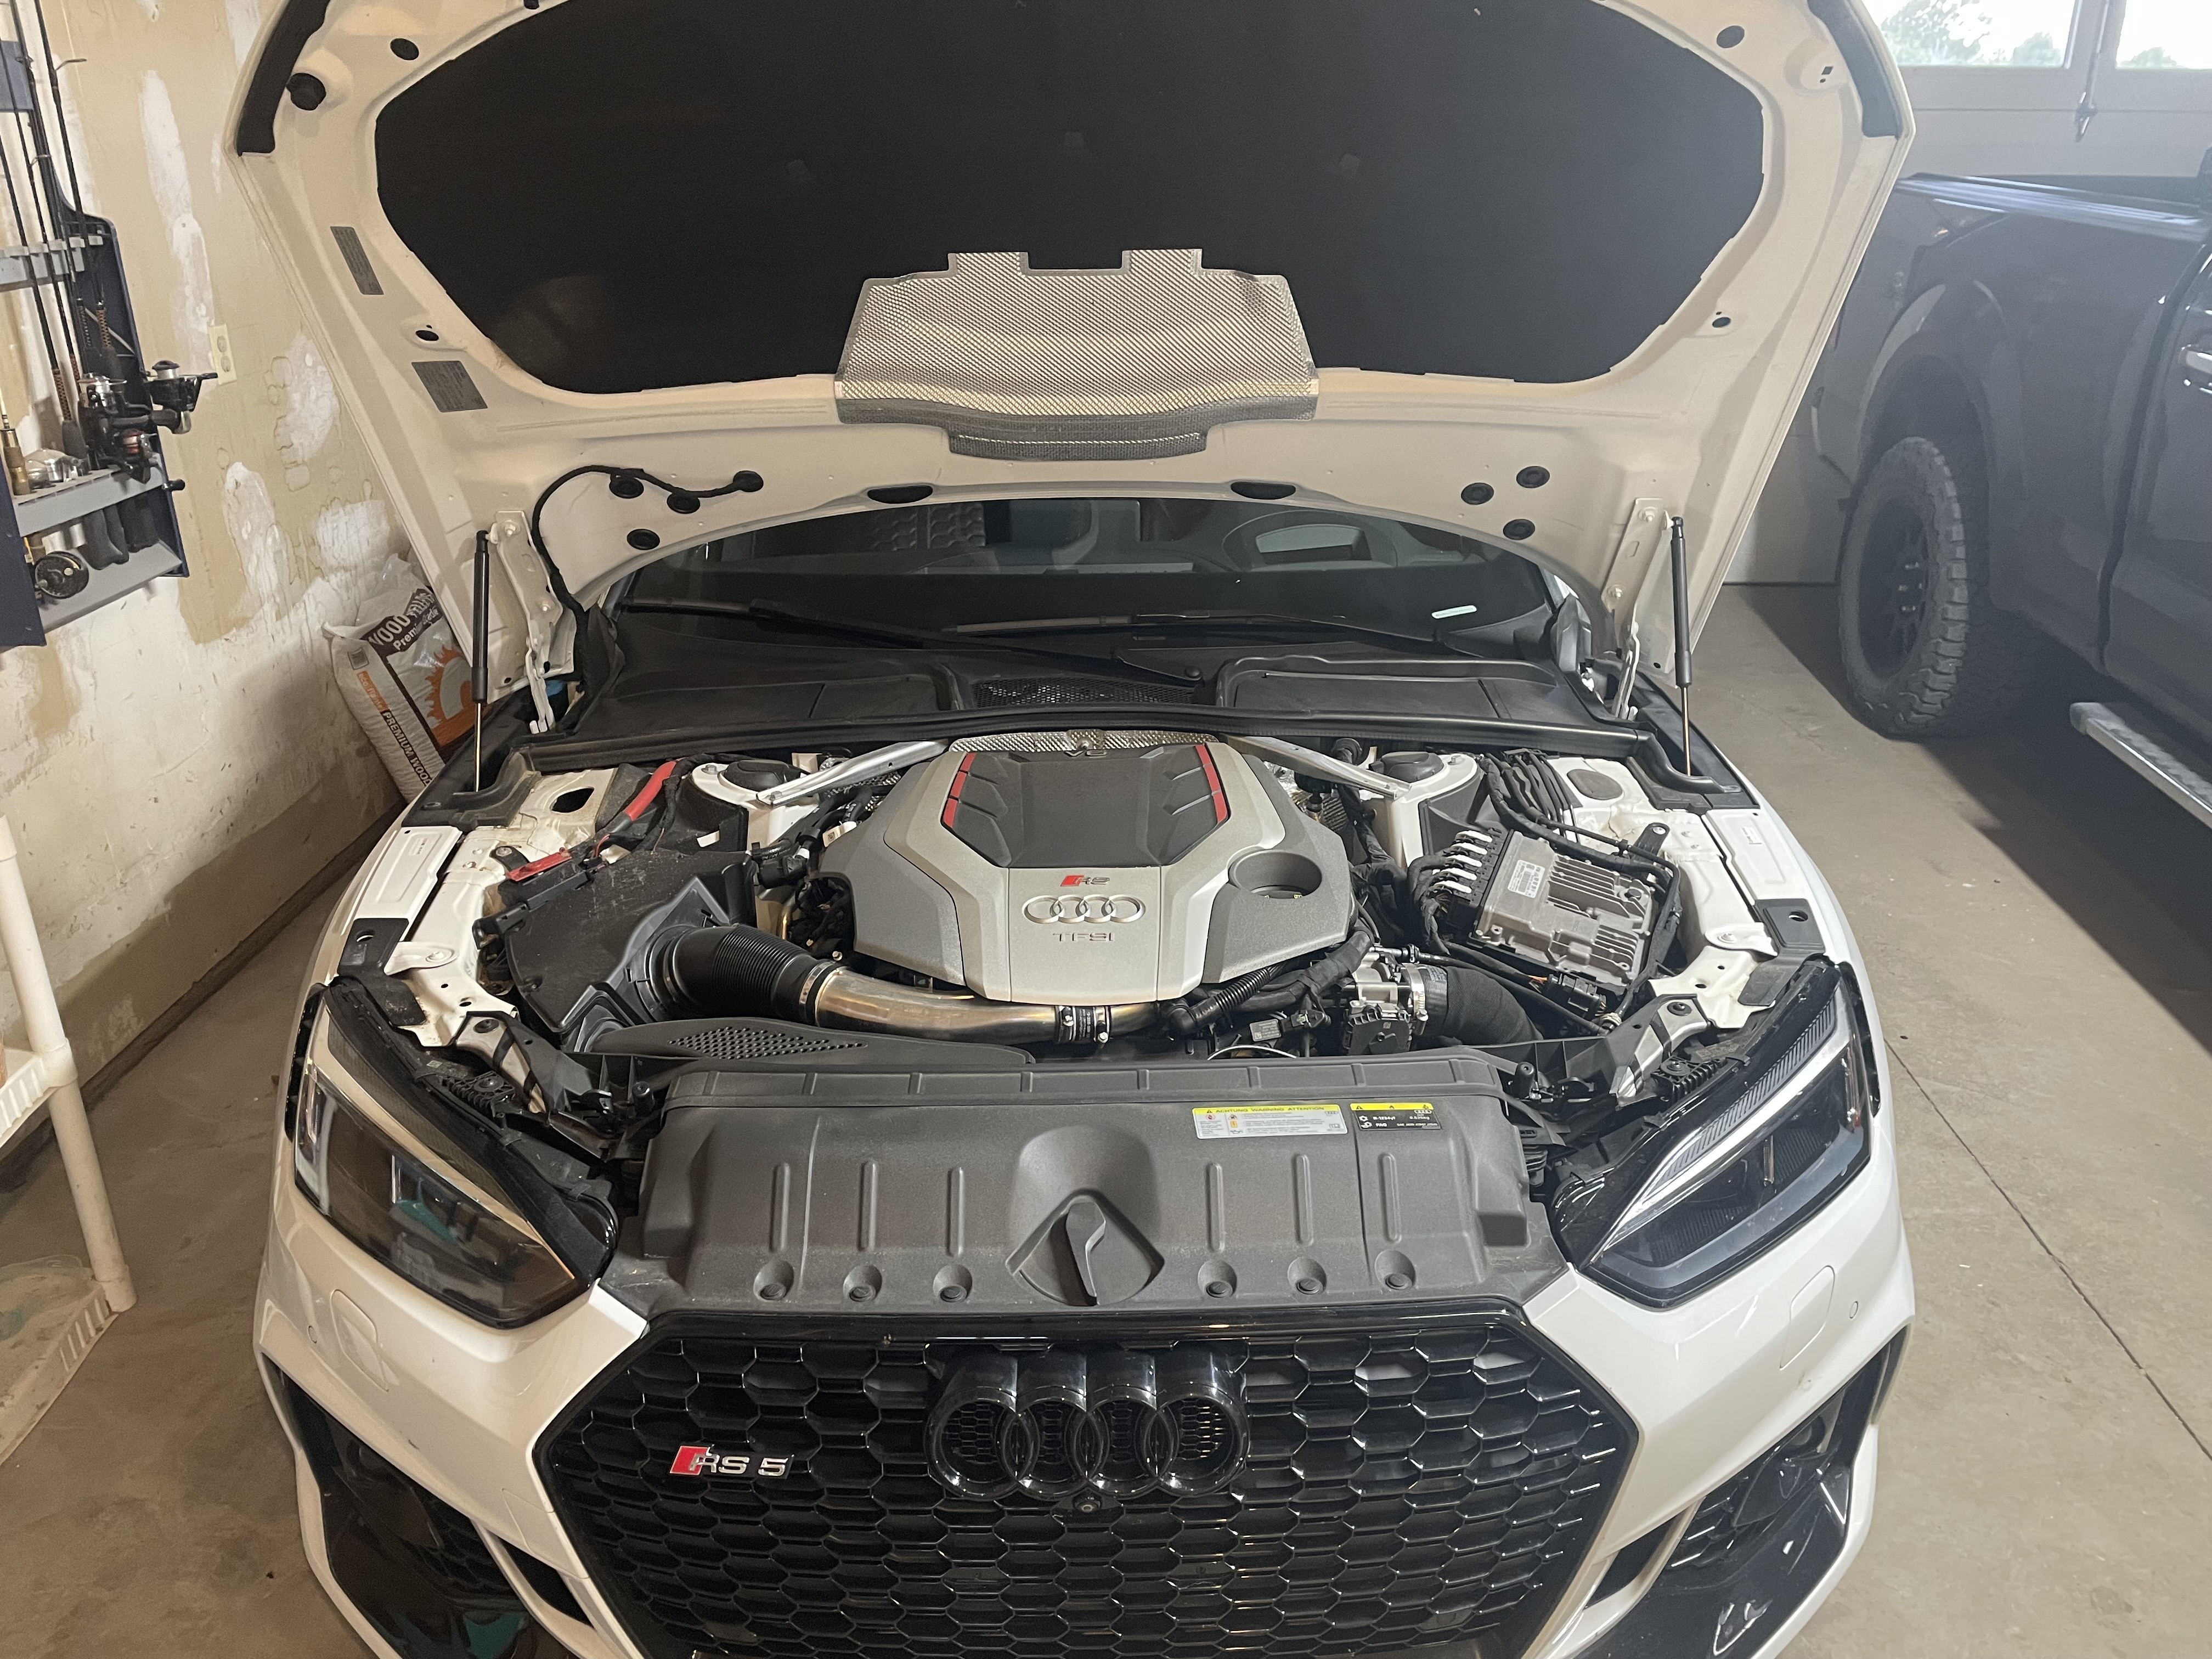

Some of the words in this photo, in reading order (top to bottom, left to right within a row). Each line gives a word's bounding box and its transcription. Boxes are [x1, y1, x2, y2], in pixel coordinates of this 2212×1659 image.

[382, 712, 414, 757] PREMIUM
[411, 758, 432, 786] WOOD
[1052, 933, 1115, 941] TFSI
[689, 1451, 750, 1475] RS
[758, 1457, 788, 1477] 5
